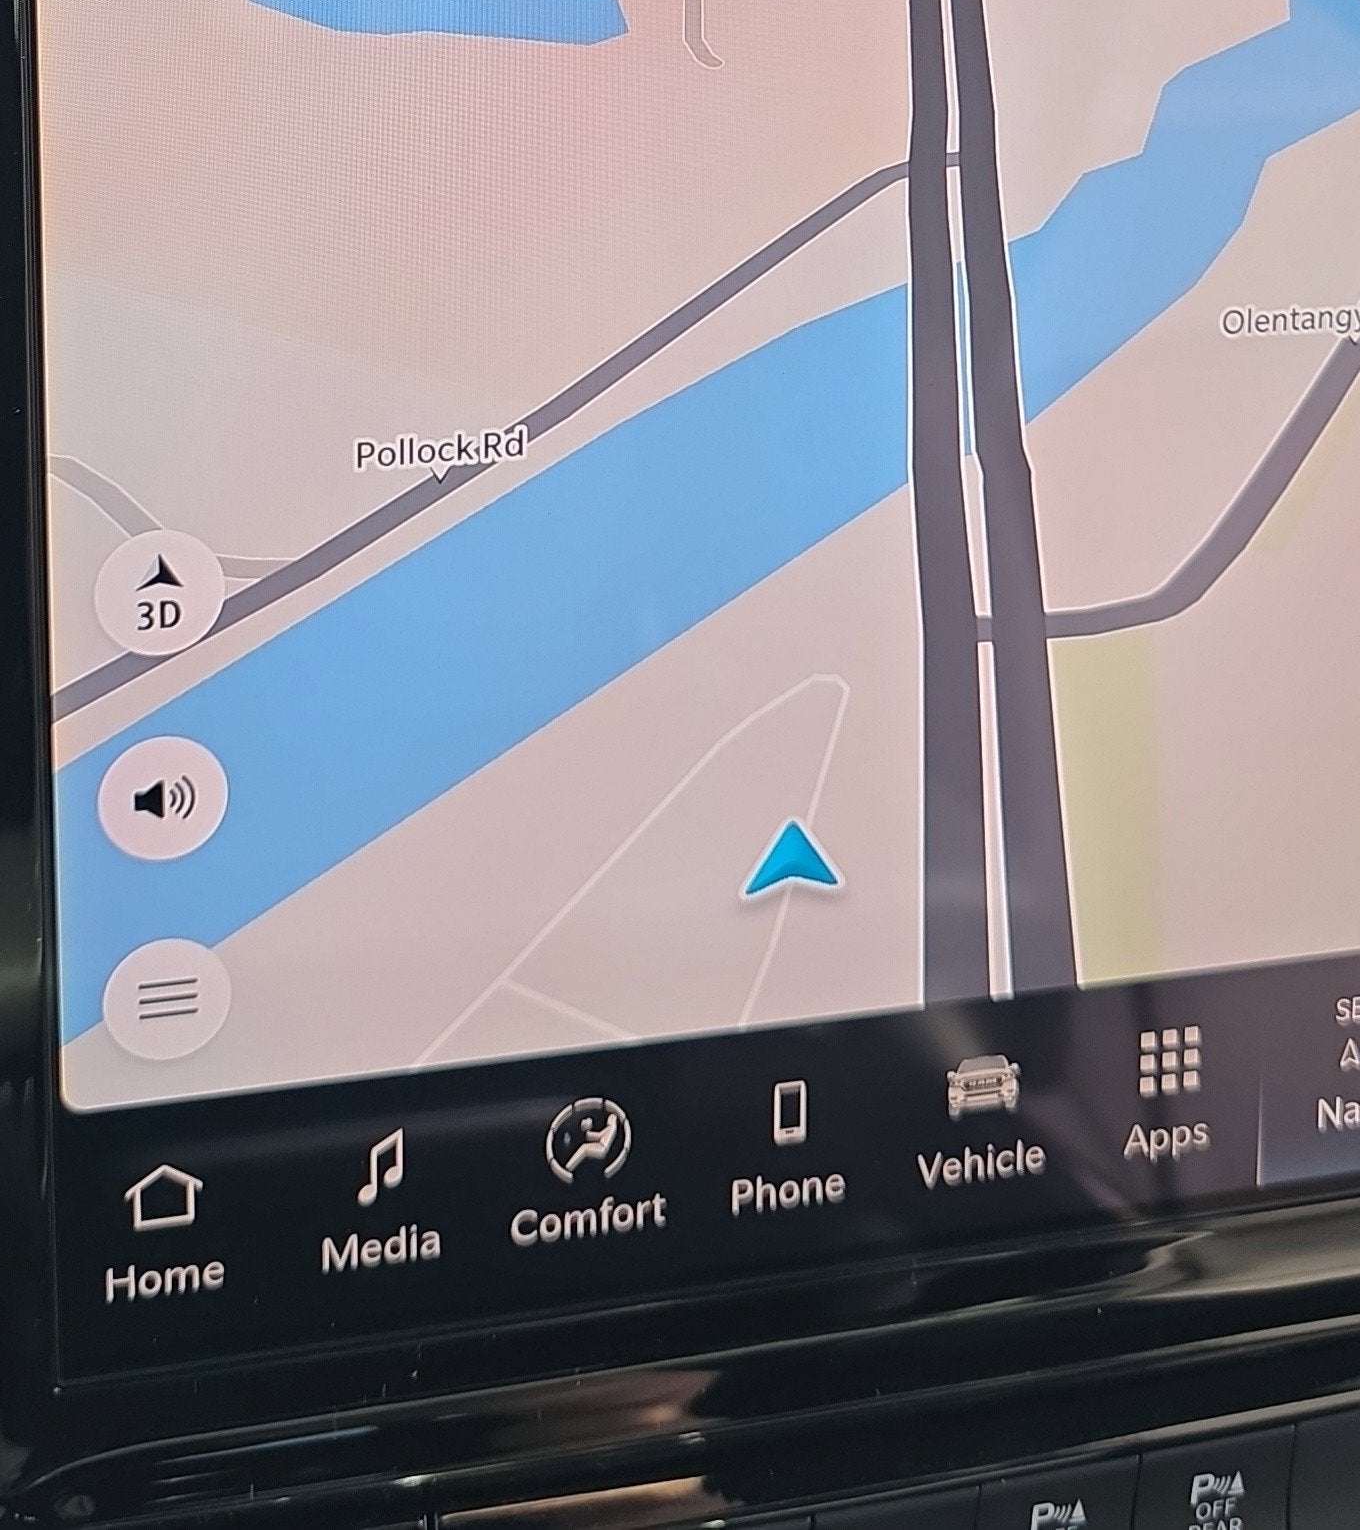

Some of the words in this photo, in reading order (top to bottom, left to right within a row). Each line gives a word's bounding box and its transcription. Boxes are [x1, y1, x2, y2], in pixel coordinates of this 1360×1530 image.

[356, 433, 474, 468] Pollock
[484, 429, 525, 459] Rd
[136, 600, 181, 631] 3D
[1122, 1119, 1211, 1160] Apps
[916, 1139, 1047, 1190] Vehicle
[730, 1169, 847, 1216] Phone
[510, 1191, 667, 1247] Comfort
[321, 1224, 442, 1273] Media
[105, 1259, 226, 1304] Home
[1188, 1517, 1243, 1530] AR
[1195, 1497, 1238, 1521] OFF
